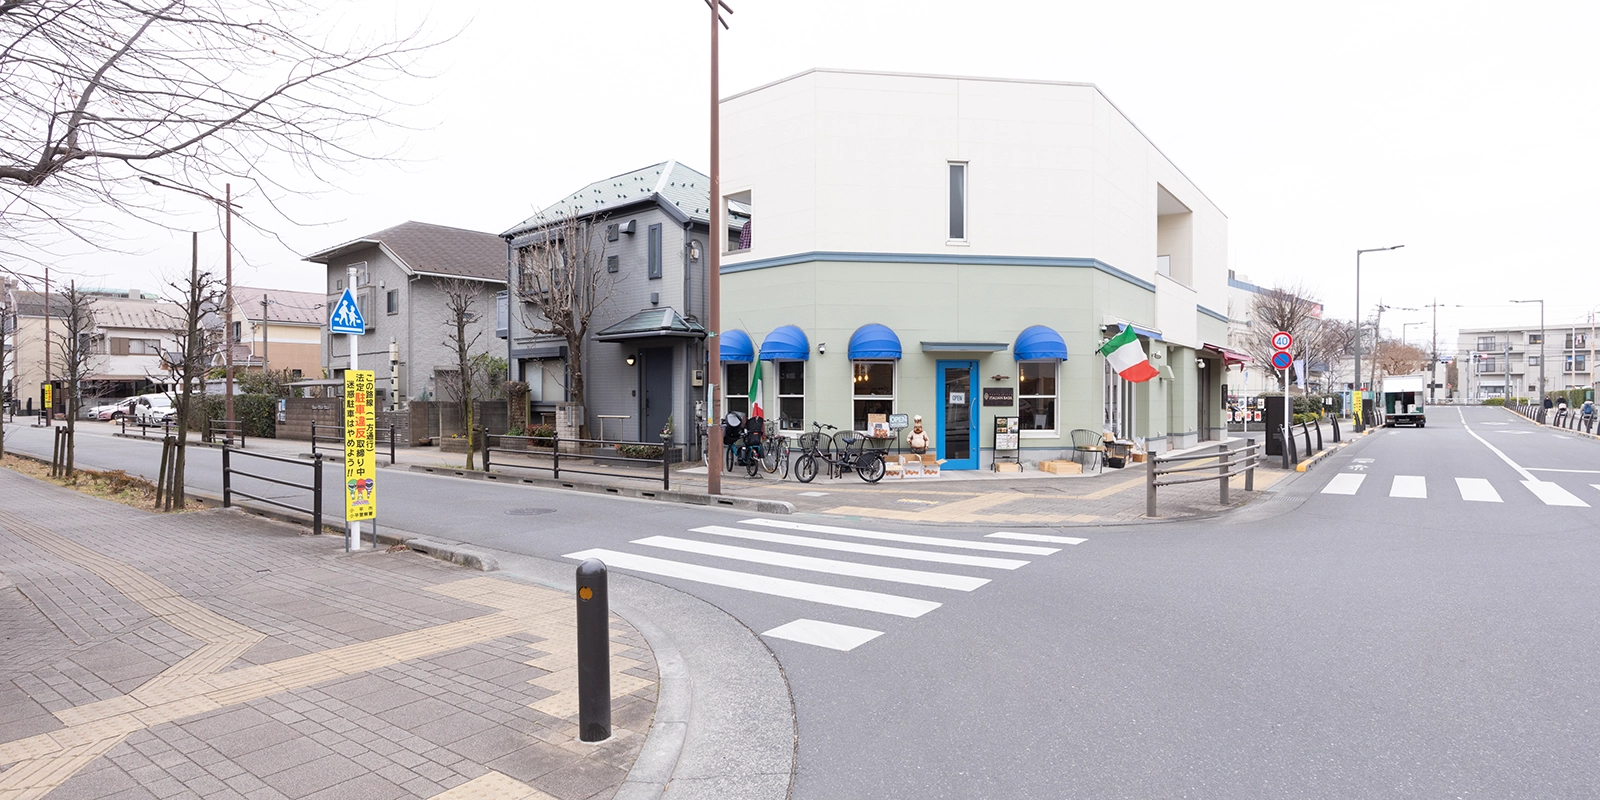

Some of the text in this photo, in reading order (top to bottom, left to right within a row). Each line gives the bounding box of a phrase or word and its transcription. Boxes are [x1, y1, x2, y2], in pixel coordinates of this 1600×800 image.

[1276, 337, 1288, 345] 40
[890, 415, 907, 424] OPEN
[355, 373, 366, 476] 法定駐車違反取締り中
